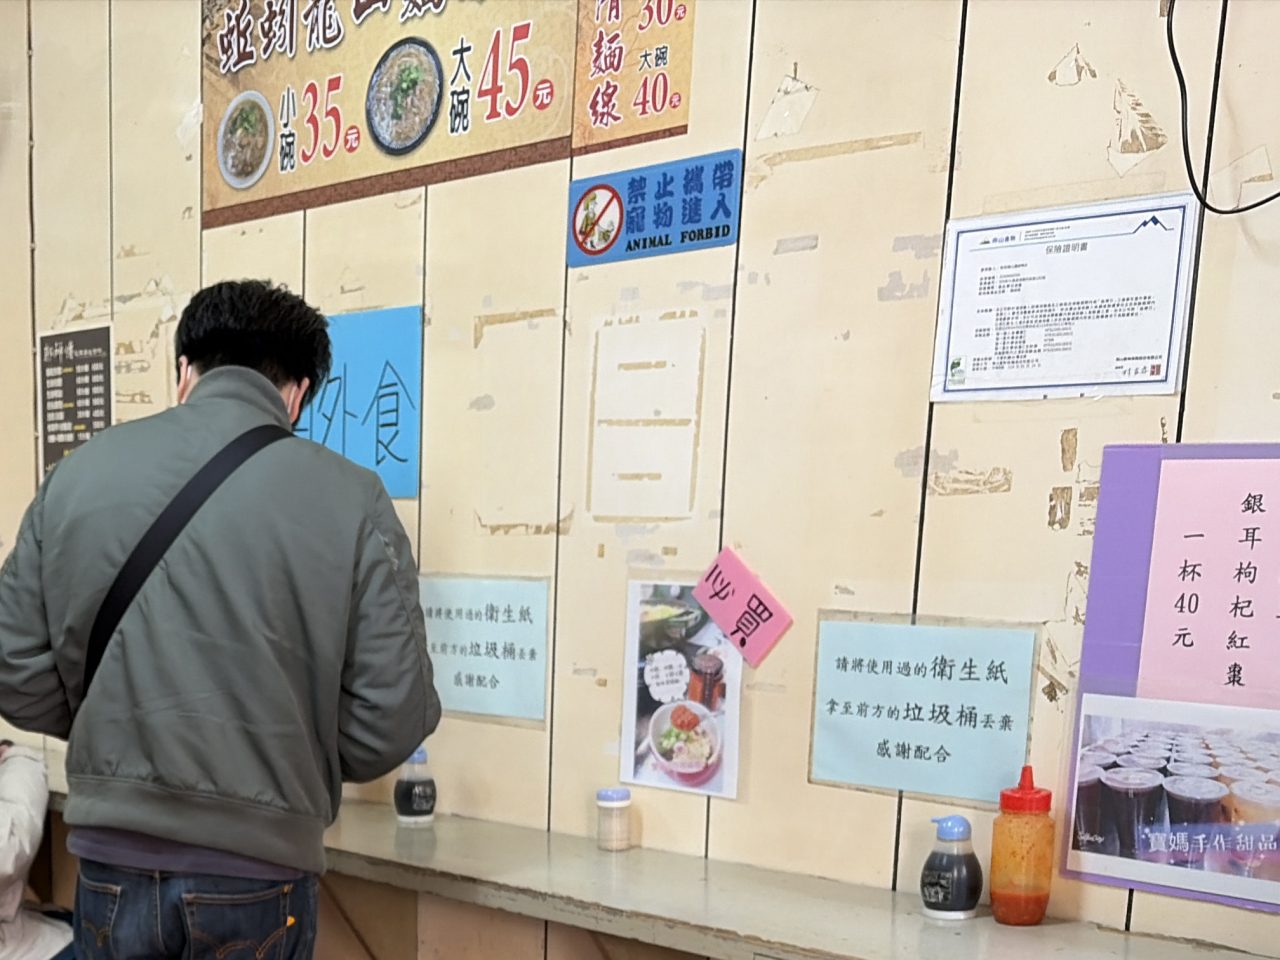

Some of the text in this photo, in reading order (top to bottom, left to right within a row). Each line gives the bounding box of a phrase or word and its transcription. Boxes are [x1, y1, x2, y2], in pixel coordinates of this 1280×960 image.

[638, 45, 668, 72] 大碗
[449, 38, 472, 134] 大碗
[279, 86, 296, 172] 小碗
[626, 159, 734, 205] 禁止攜帶
[625, 192, 733, 236] 寵物進入
[625, 224, 731, 253] ANIMAL FORBID
[1045, 241, 1089, 255] 保險證明書
[293, 360, 417, 466] 外食
[704, 563, 774, 649] 必買
[1172, 533, 1205, 648] 一杯40元
[1224, 493, 1266, 688] 銀耳枸杞紅棗
[425, 602, 534, 624] 請將使用過的衛生紙
[427, 641, 538, 661] 至前方的垃圾桶丟棄
[454, 670, 500, 690] 感謝配合
[834, 654, 1009, 685] 請將使用過的衛生紙
[825, 698, 1014, 731] 拿至前方的垃圾桶丟棄
[875, 739, 951, 763] 感謝配合
